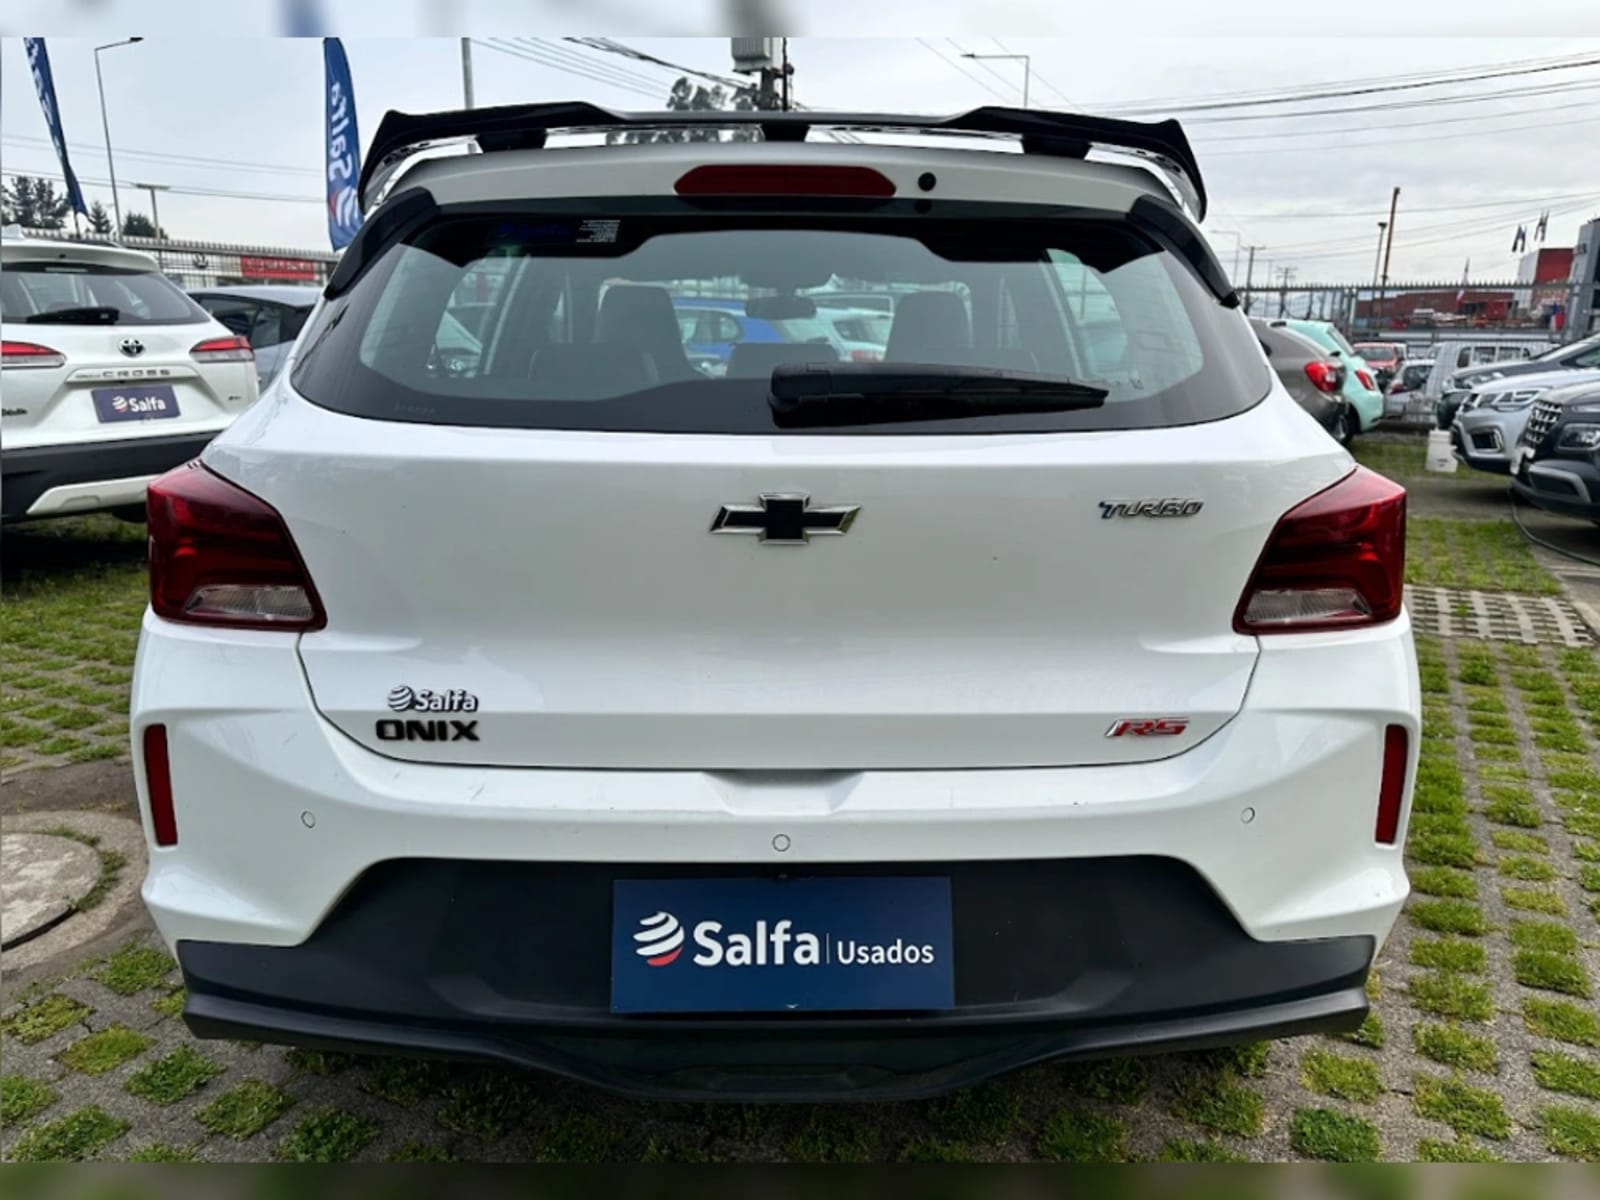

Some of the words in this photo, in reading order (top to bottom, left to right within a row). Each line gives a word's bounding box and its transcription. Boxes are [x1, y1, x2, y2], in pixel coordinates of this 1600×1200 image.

[129, 397, 166, 412] Salfa
[1099, 500, 1203, 519] TURBO
[414, 689, 479, 712] Salfa
[376, 719, 480, 741] ONIX
[1105, 717, 1190, 737] RS
[693, 920, 819, 966] Salfa
[837, 939, 935, 964] Usados
